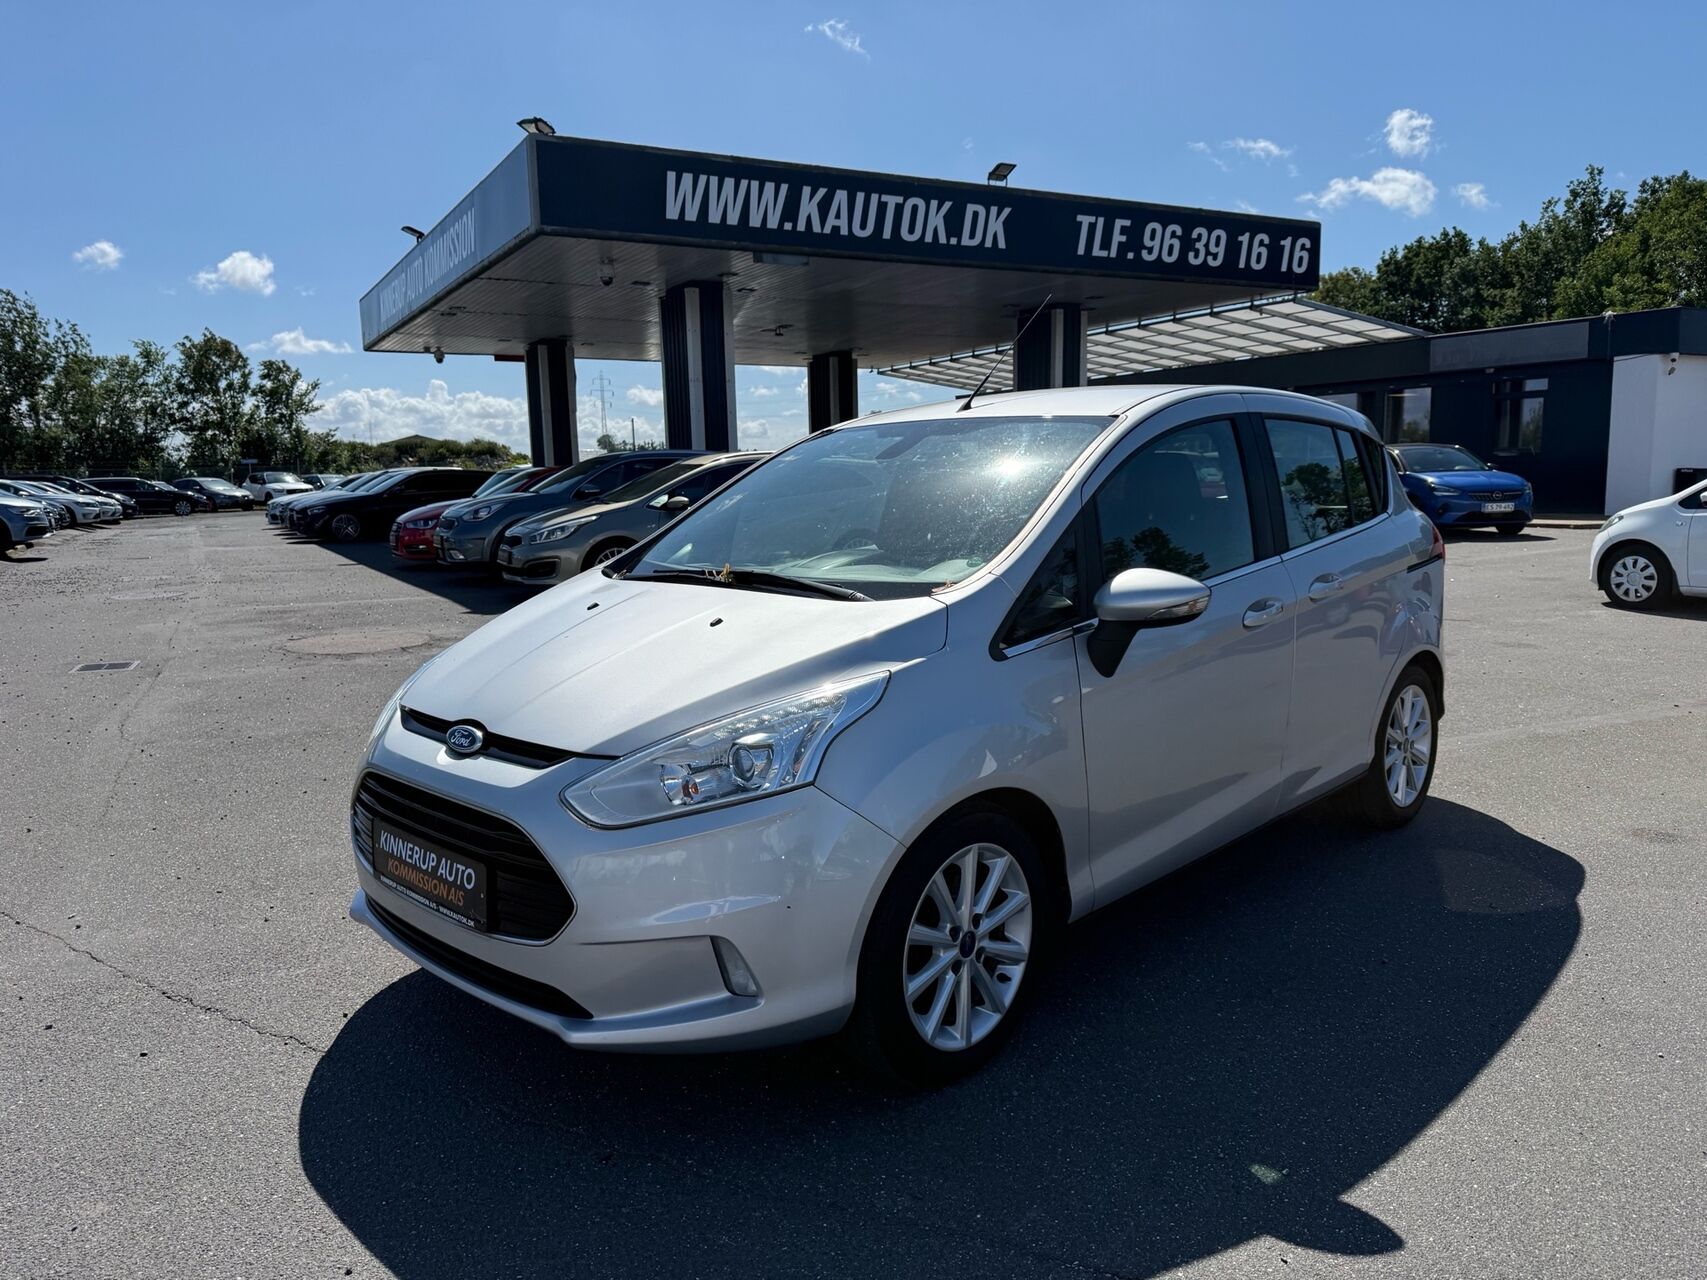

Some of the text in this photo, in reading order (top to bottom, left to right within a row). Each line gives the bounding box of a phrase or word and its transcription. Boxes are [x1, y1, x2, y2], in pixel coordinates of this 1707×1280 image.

[665, 170, 1012, 250] WWW.KAUTOK.DK
[425, 208, 475, 289] KOMMISSION
[1075, 214, 1312, 274] TLF. 96 39 16 16
[450, 729, 472, 747] Ford
[380, 830, 475, 890] KINNERUP AUTO
[387, 858, 447, 900] KOMMISSION
